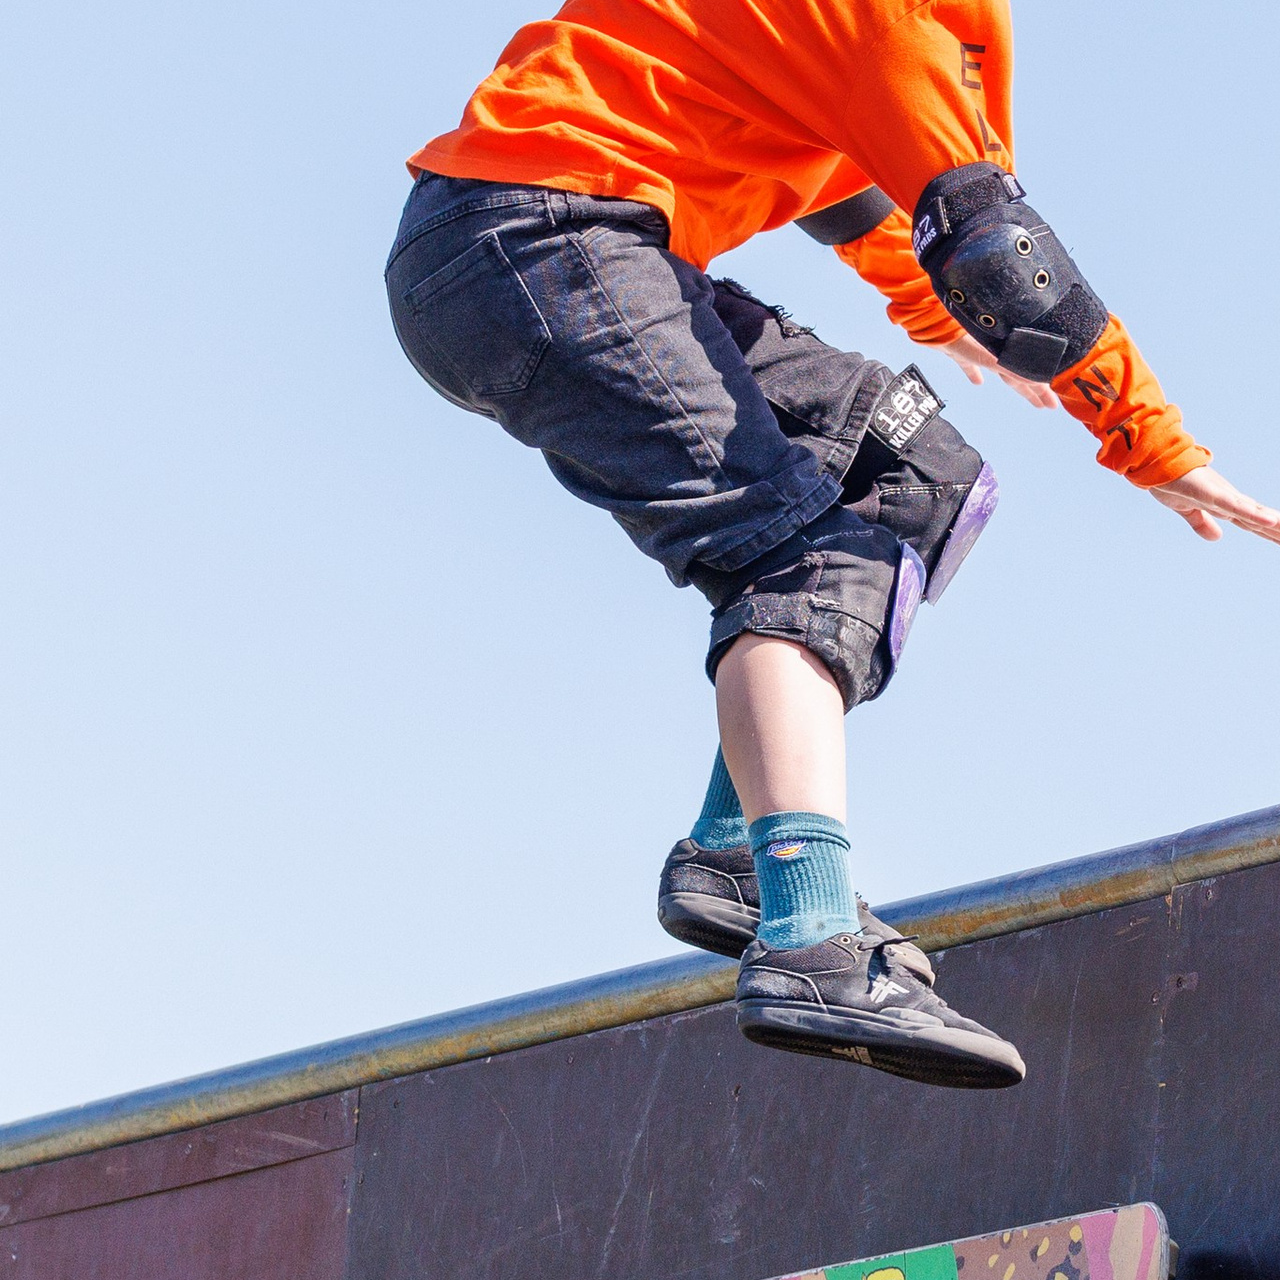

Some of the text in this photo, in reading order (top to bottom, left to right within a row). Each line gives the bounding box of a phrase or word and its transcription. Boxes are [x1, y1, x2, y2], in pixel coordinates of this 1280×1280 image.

[919, 227, 937, 251] PADS
[877, 379, 925, 433] 187
[889, 411, 925, 449] KILLER
